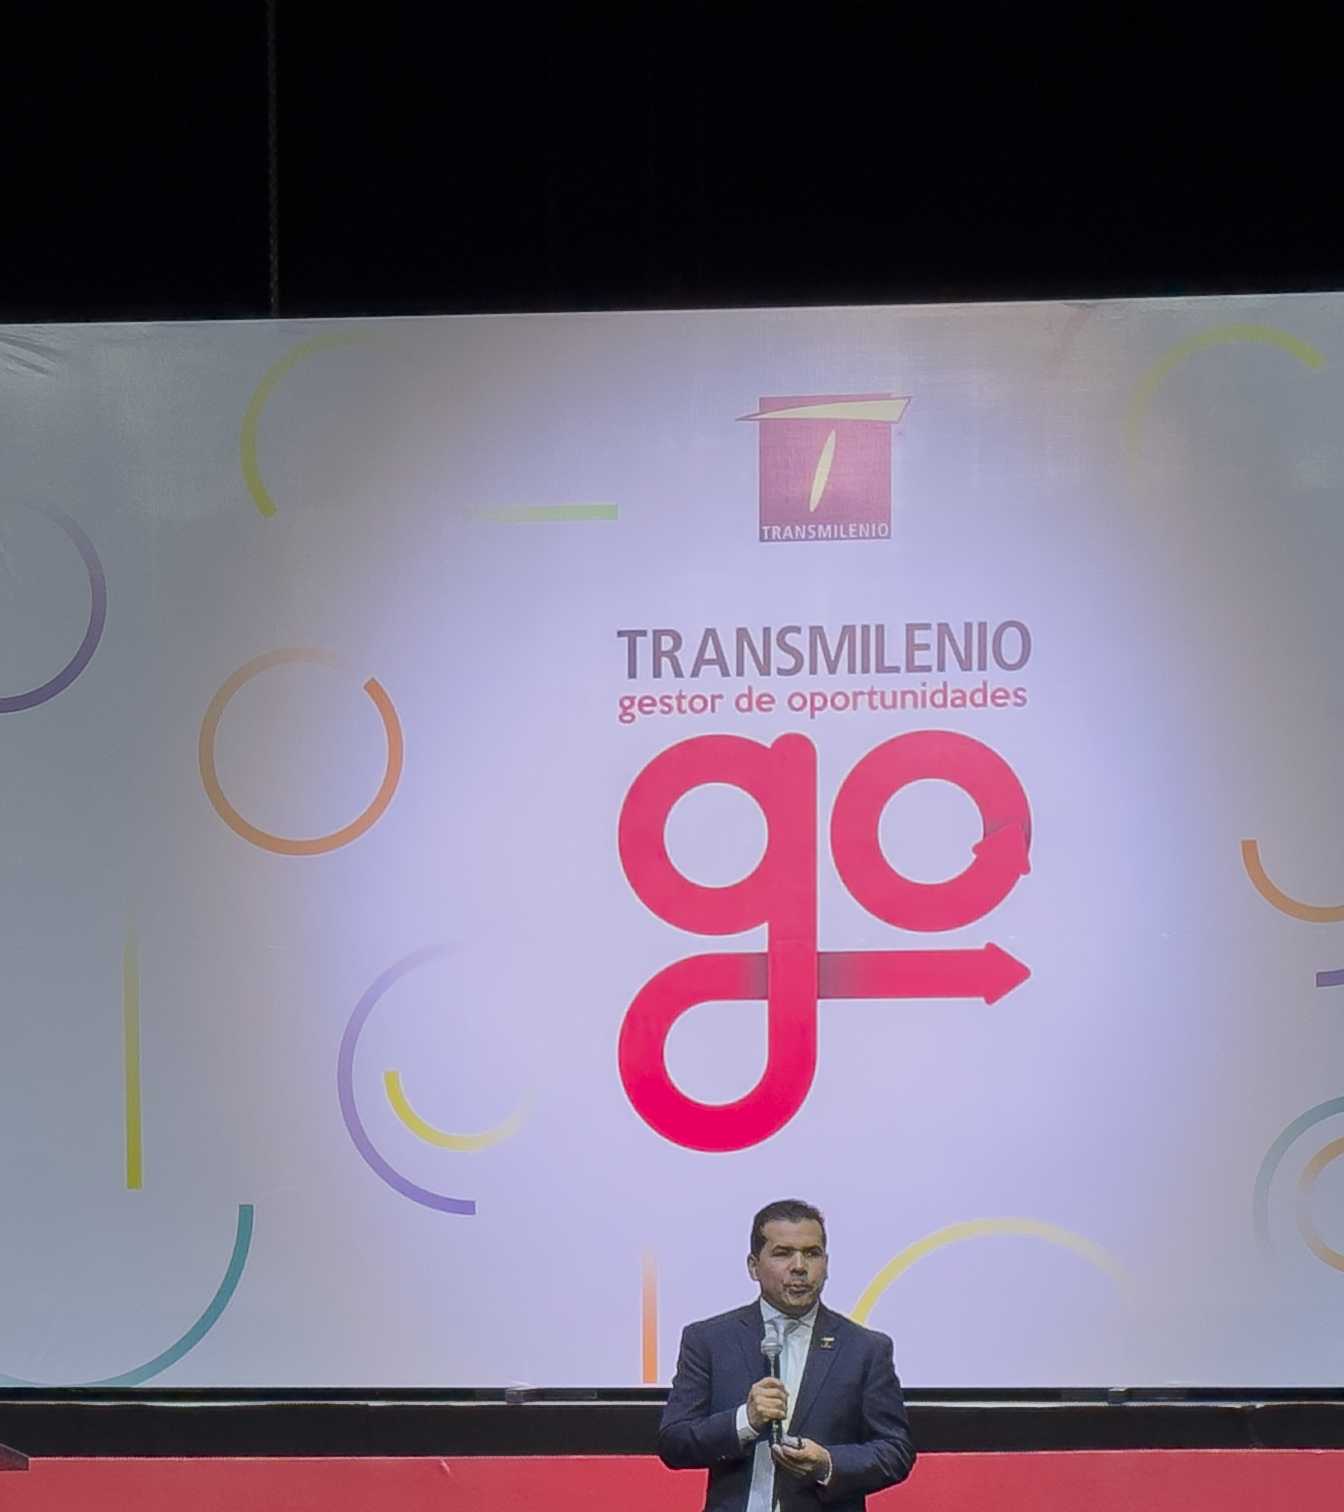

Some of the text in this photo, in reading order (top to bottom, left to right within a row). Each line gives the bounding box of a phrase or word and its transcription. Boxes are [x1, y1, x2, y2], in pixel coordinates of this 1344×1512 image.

[762, 522, 889, 540] TRANSMILENIO
[617, 620, 1032, 679] TRANSMILENIO
[618, 681, 1027, 723] gestor de oportunidades
[618, 729, 1032, 1154] go
